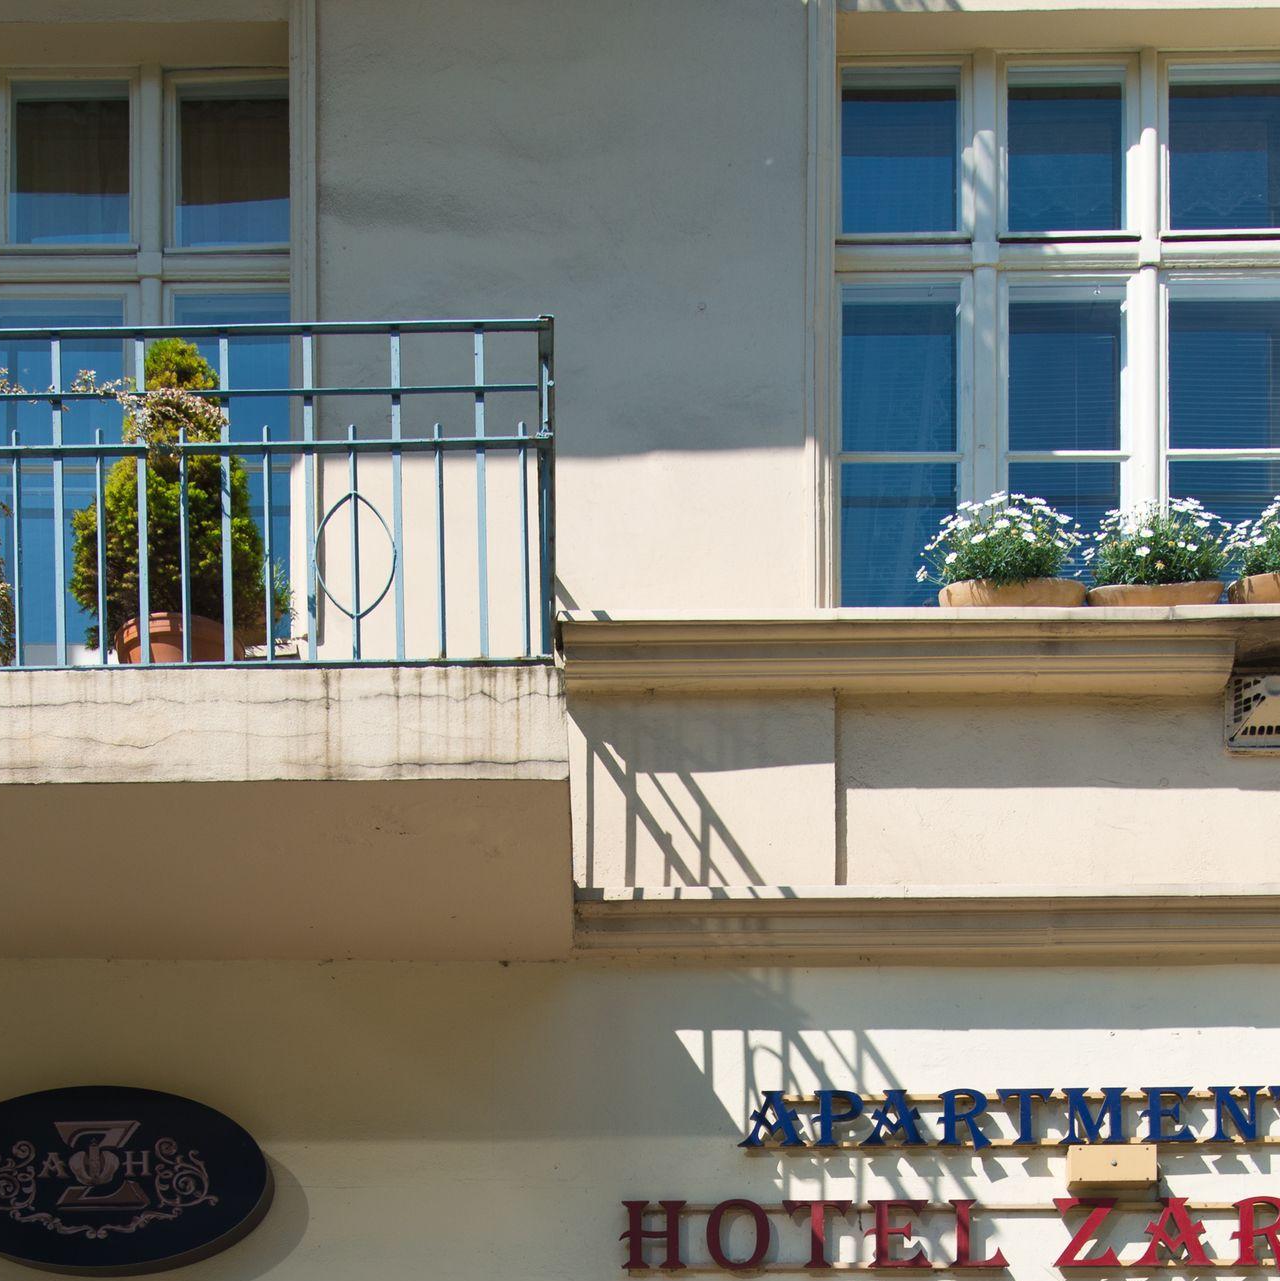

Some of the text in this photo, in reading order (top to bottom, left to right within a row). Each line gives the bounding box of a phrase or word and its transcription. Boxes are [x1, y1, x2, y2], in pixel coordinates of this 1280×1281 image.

[38, 1151, 68, 1180] A
[124, 1149, 154, 1179] H
[618, 1198, 1007, 1271] HOTEL
